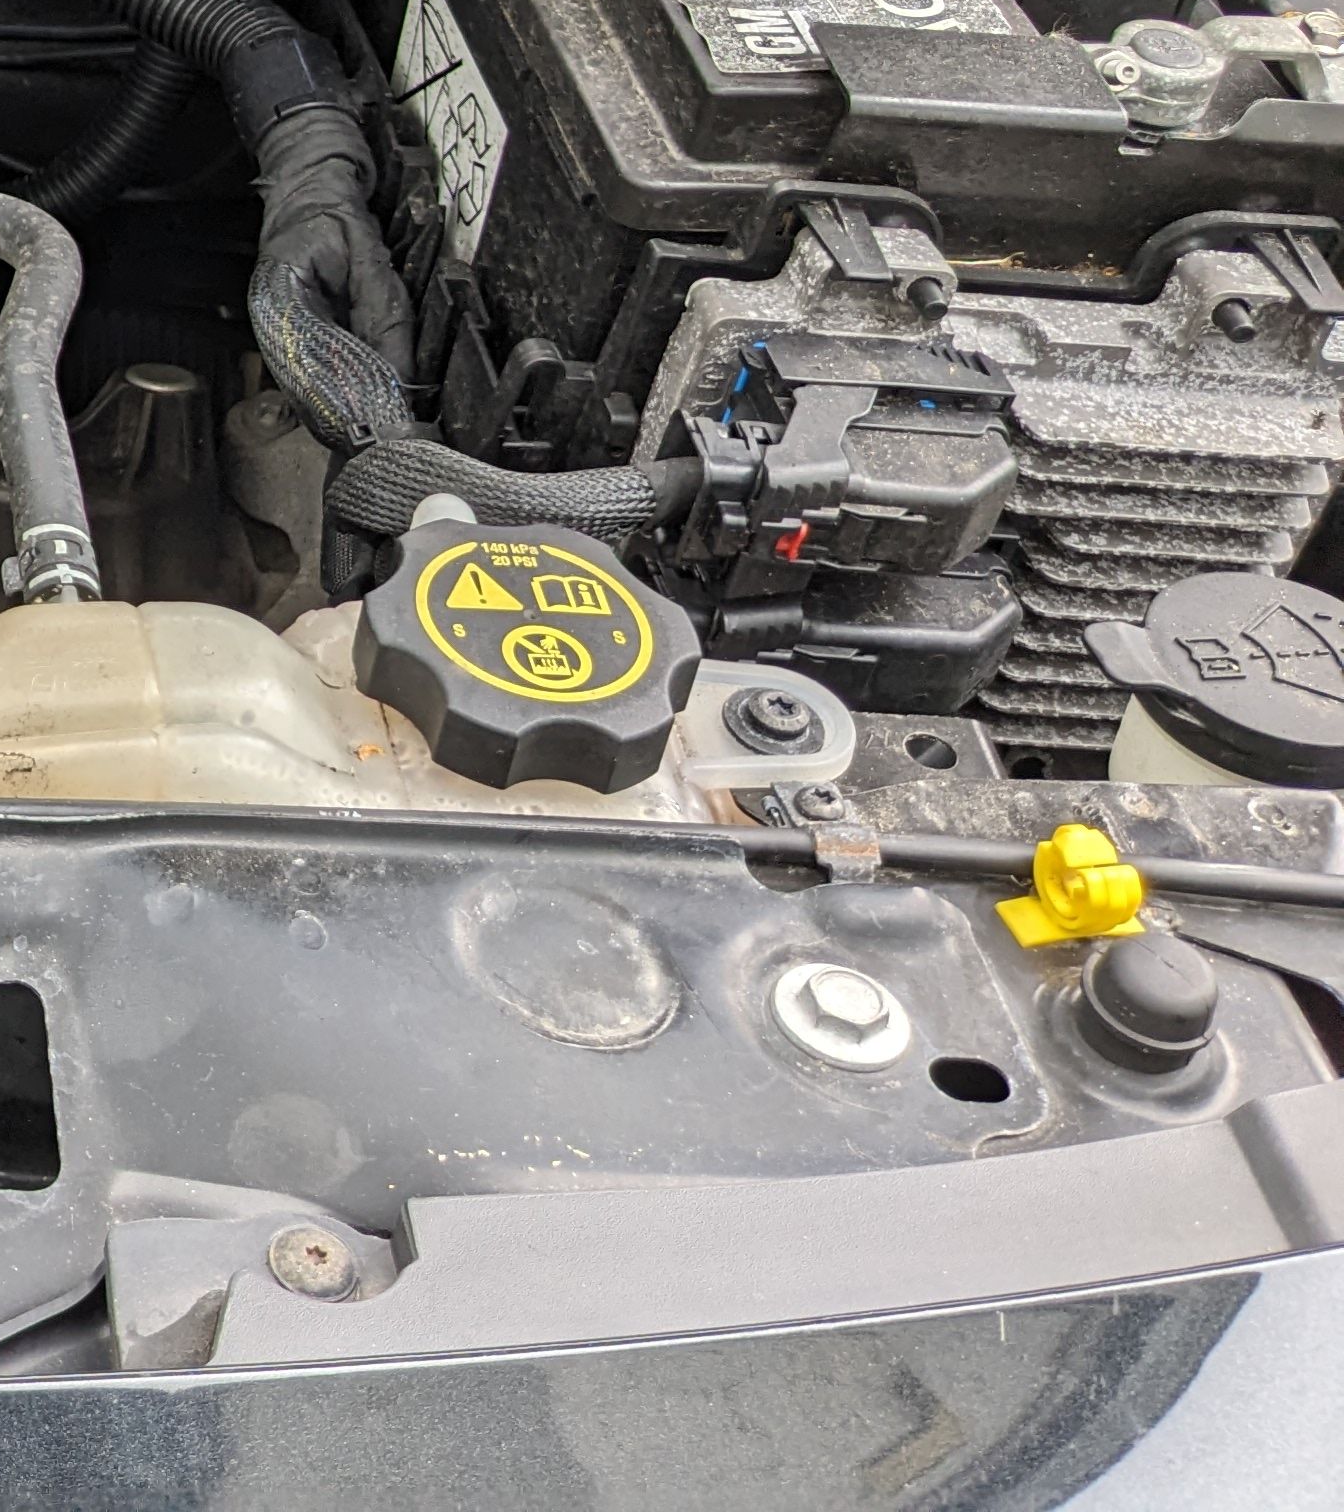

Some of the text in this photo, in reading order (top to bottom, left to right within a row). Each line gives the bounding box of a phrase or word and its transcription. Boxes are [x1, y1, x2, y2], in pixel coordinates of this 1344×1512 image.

[727, 7, 807, 55] GM
[480, 542, 539, 555] 140 kPa
[491, 555, 538, 568] 20 PSI
